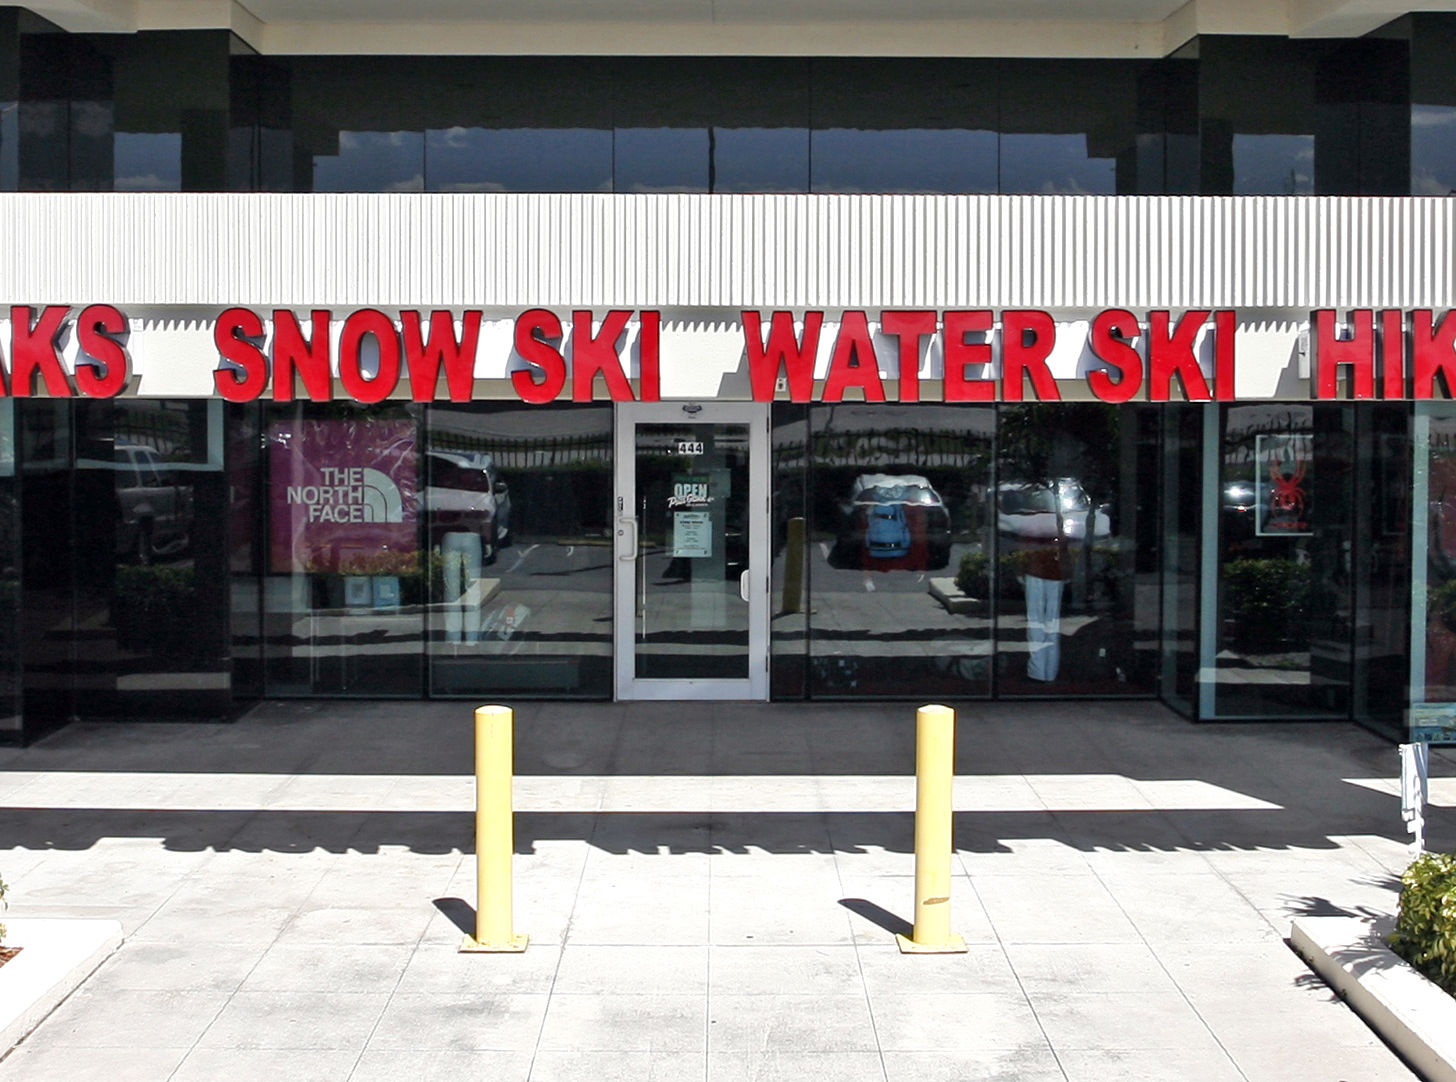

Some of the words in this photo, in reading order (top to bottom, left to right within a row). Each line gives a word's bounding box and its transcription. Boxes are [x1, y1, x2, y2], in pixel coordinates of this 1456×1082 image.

[213, 307, 484, 405] SNOW
[510, 309, 662, 404] SKI
[742, 309, 1062, 403] WATER
[1085, 309, 1237, 403] SKI
[679, 443, 703, 454] 444
[320, 467, 362, 485] THE
[287, 486, 362, 504] NORTH
[674, 483, 707, 498] OPEN
[310, 505, 362, 523] FACE
